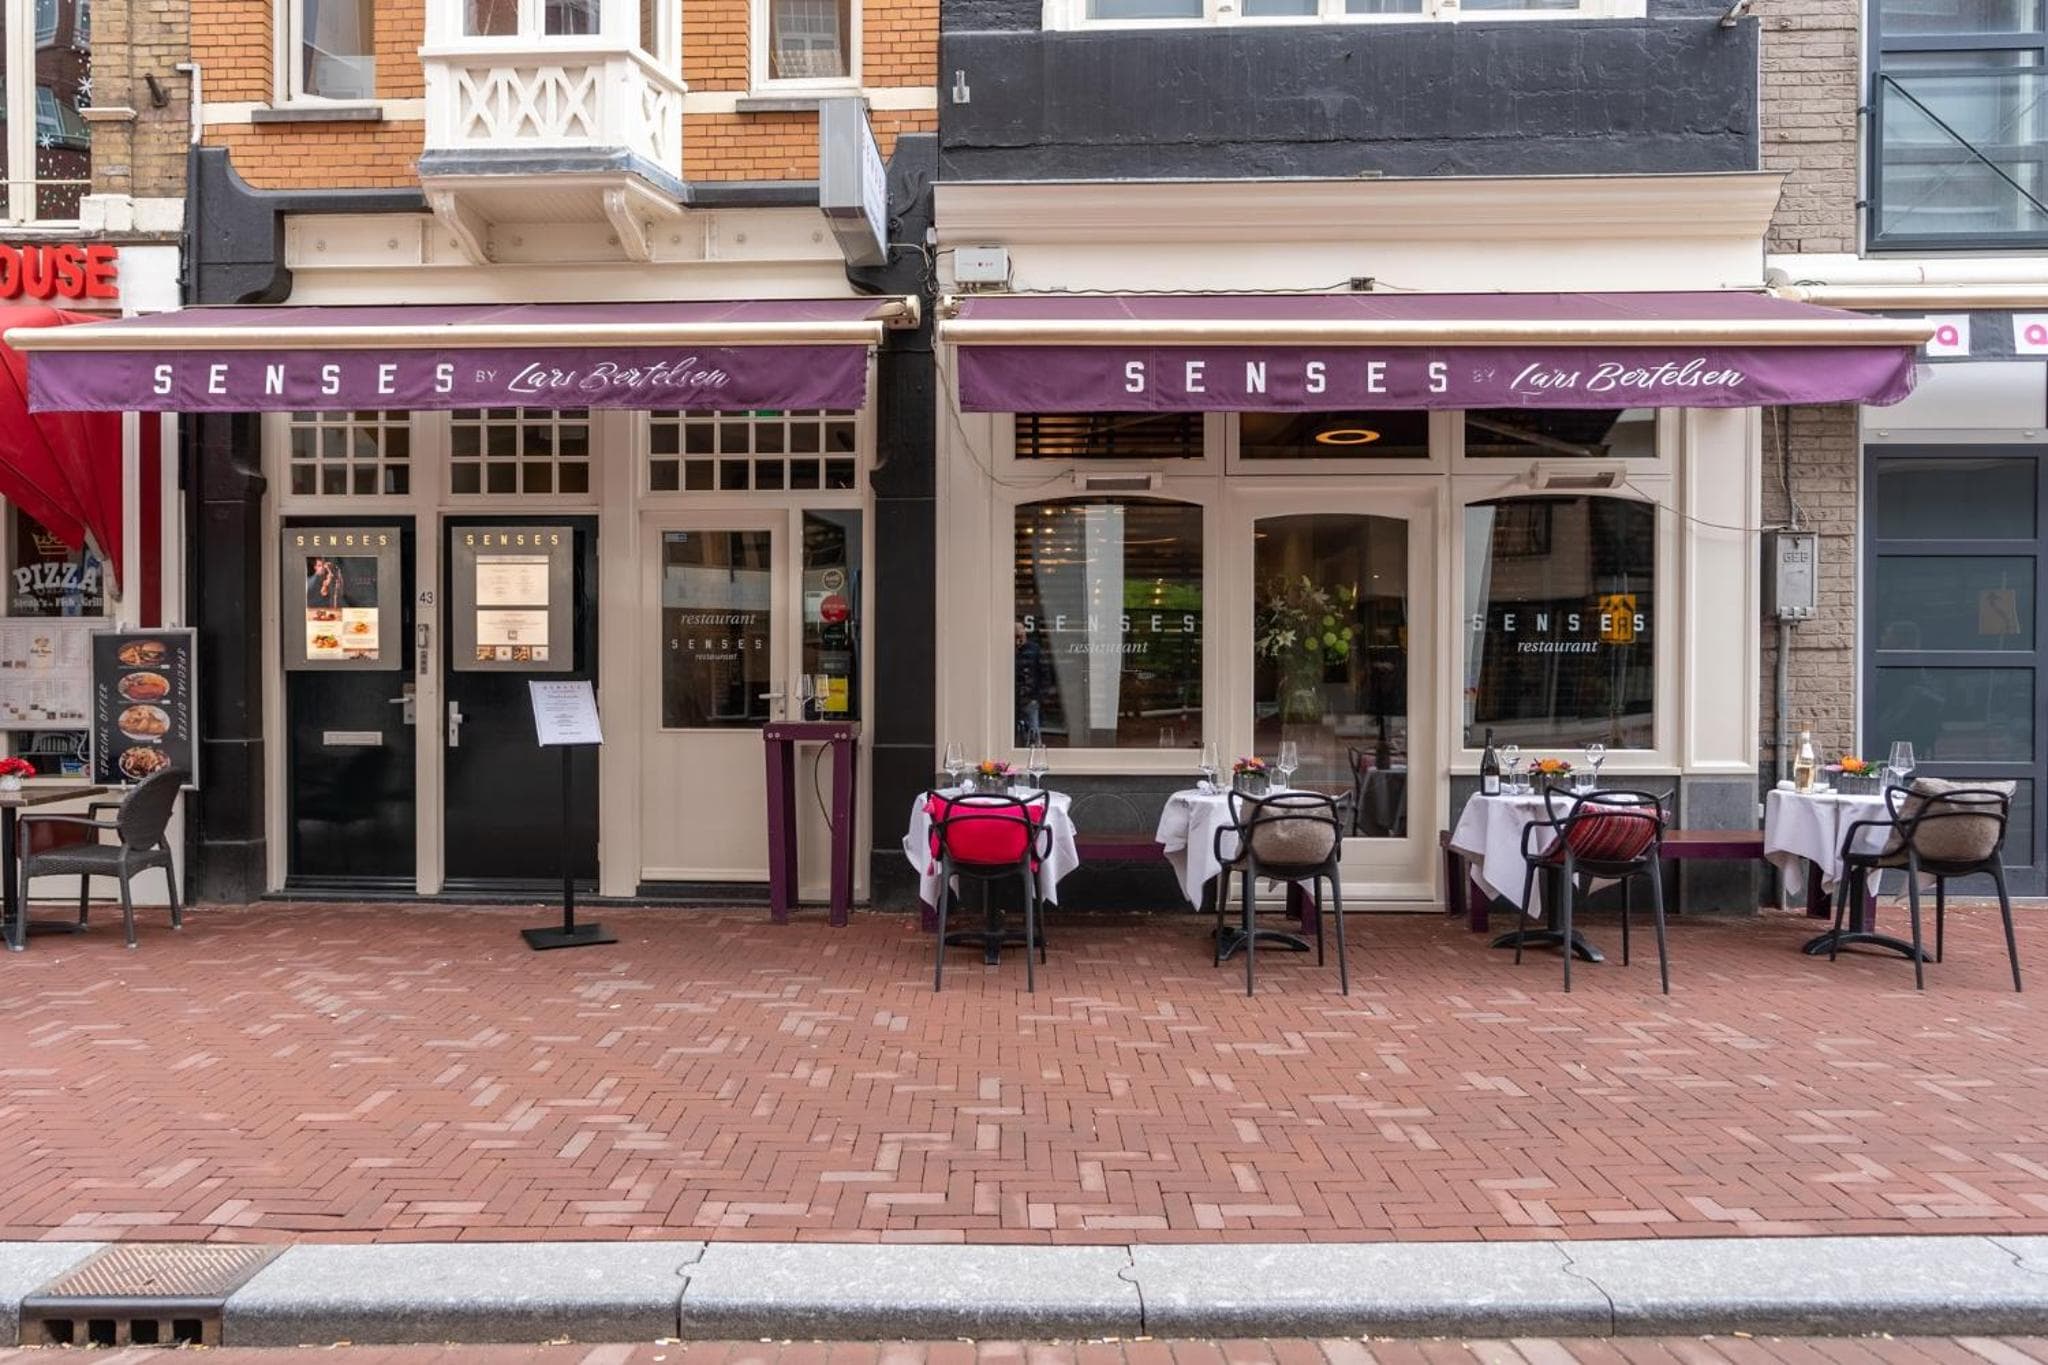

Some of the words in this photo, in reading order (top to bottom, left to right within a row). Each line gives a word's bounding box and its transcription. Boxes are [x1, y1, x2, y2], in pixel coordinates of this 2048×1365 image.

[0, 243, 119, 299] OUSE
[153, 363, 454, 395] SENSES
[475, 369, 498, 383] BY
[508, 362, 577, 393] Lars
[579, 356, 731, 392] Bertelsen
[1125, 361, 1449, 393] SENSES
[1510, 362, 1582, 395] Lars
[1586, 358, 1746, 391] Bertelsen
[296, 535, 388, 547] SENSES
[465, 534, 559, 545] SENSES
[13, 562, 98, 594] PIZZA
[419, 591, 434, 605] 43
[680, 613, 756, 625] restaurant
[1024, 615, 1195, 633] SENSES
[1472, 614, 1645, 631] SENSES
[671, 638, 763, 650] SENSES
[1068, 641, 1149, 653] restaurant
[1517, 640, 1598, 652] restaurant
[99, 683, 109, 722] OFFER
